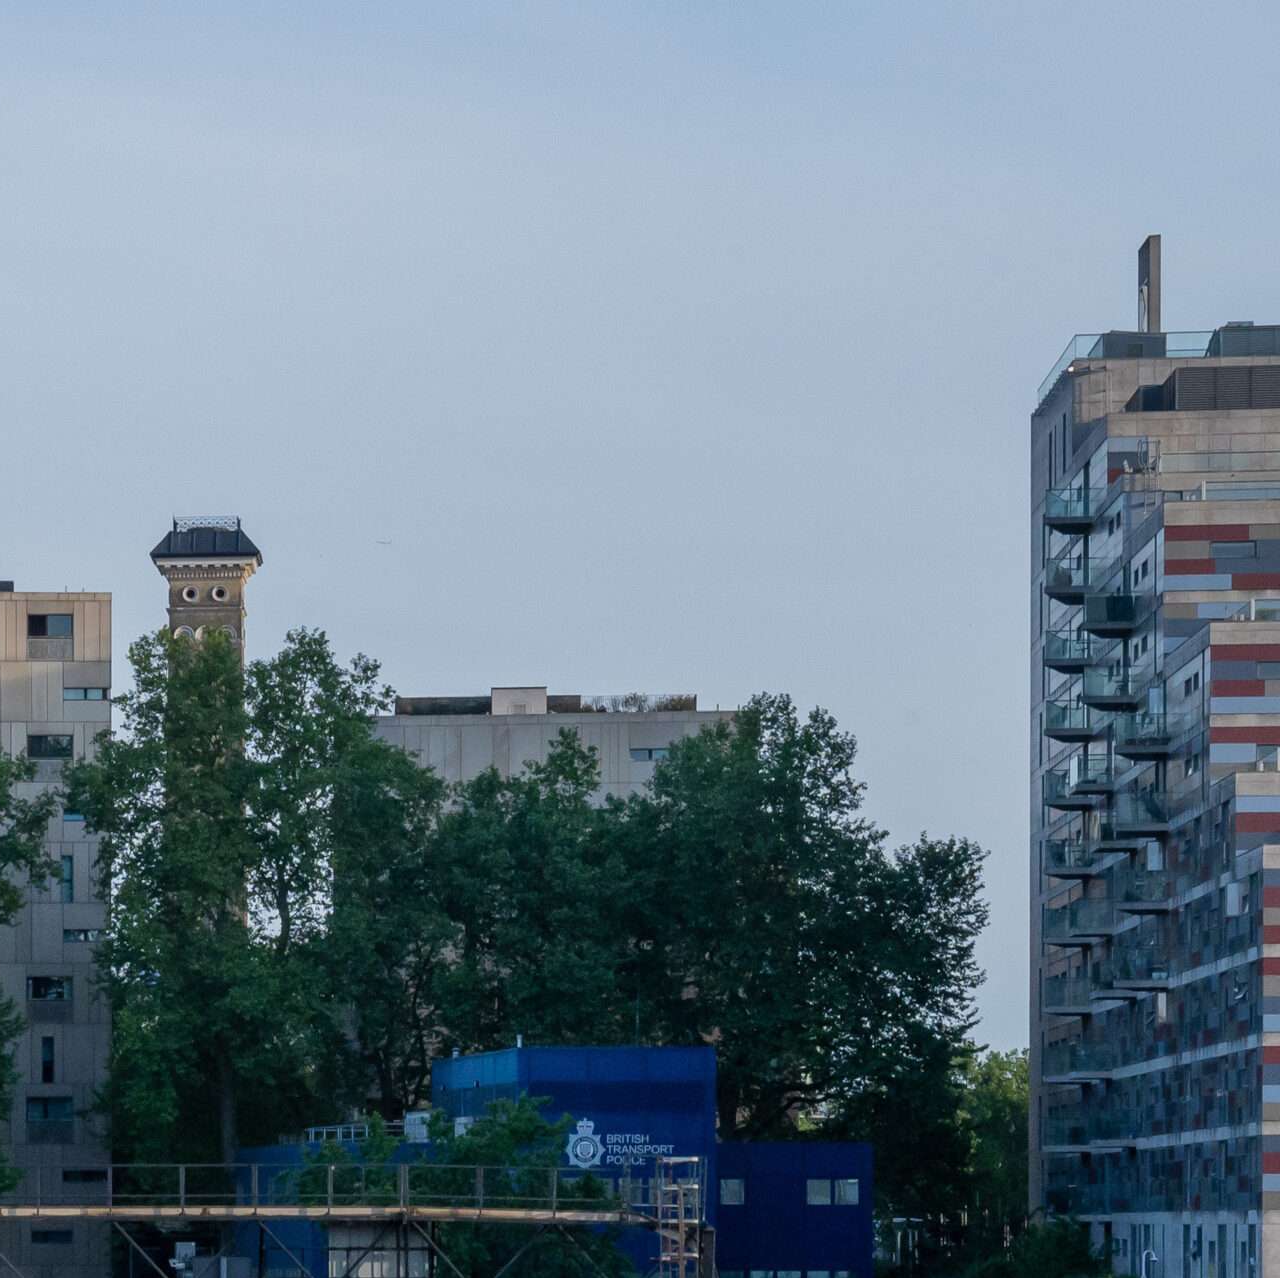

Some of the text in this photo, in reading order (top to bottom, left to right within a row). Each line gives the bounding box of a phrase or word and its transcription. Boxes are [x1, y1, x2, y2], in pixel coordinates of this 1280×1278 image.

[606, 1133, 650, 1144] BRITISH
[606, 1144, 675, 1155] TRANSPORT
[606, 1155, 647, 1165] POCE
